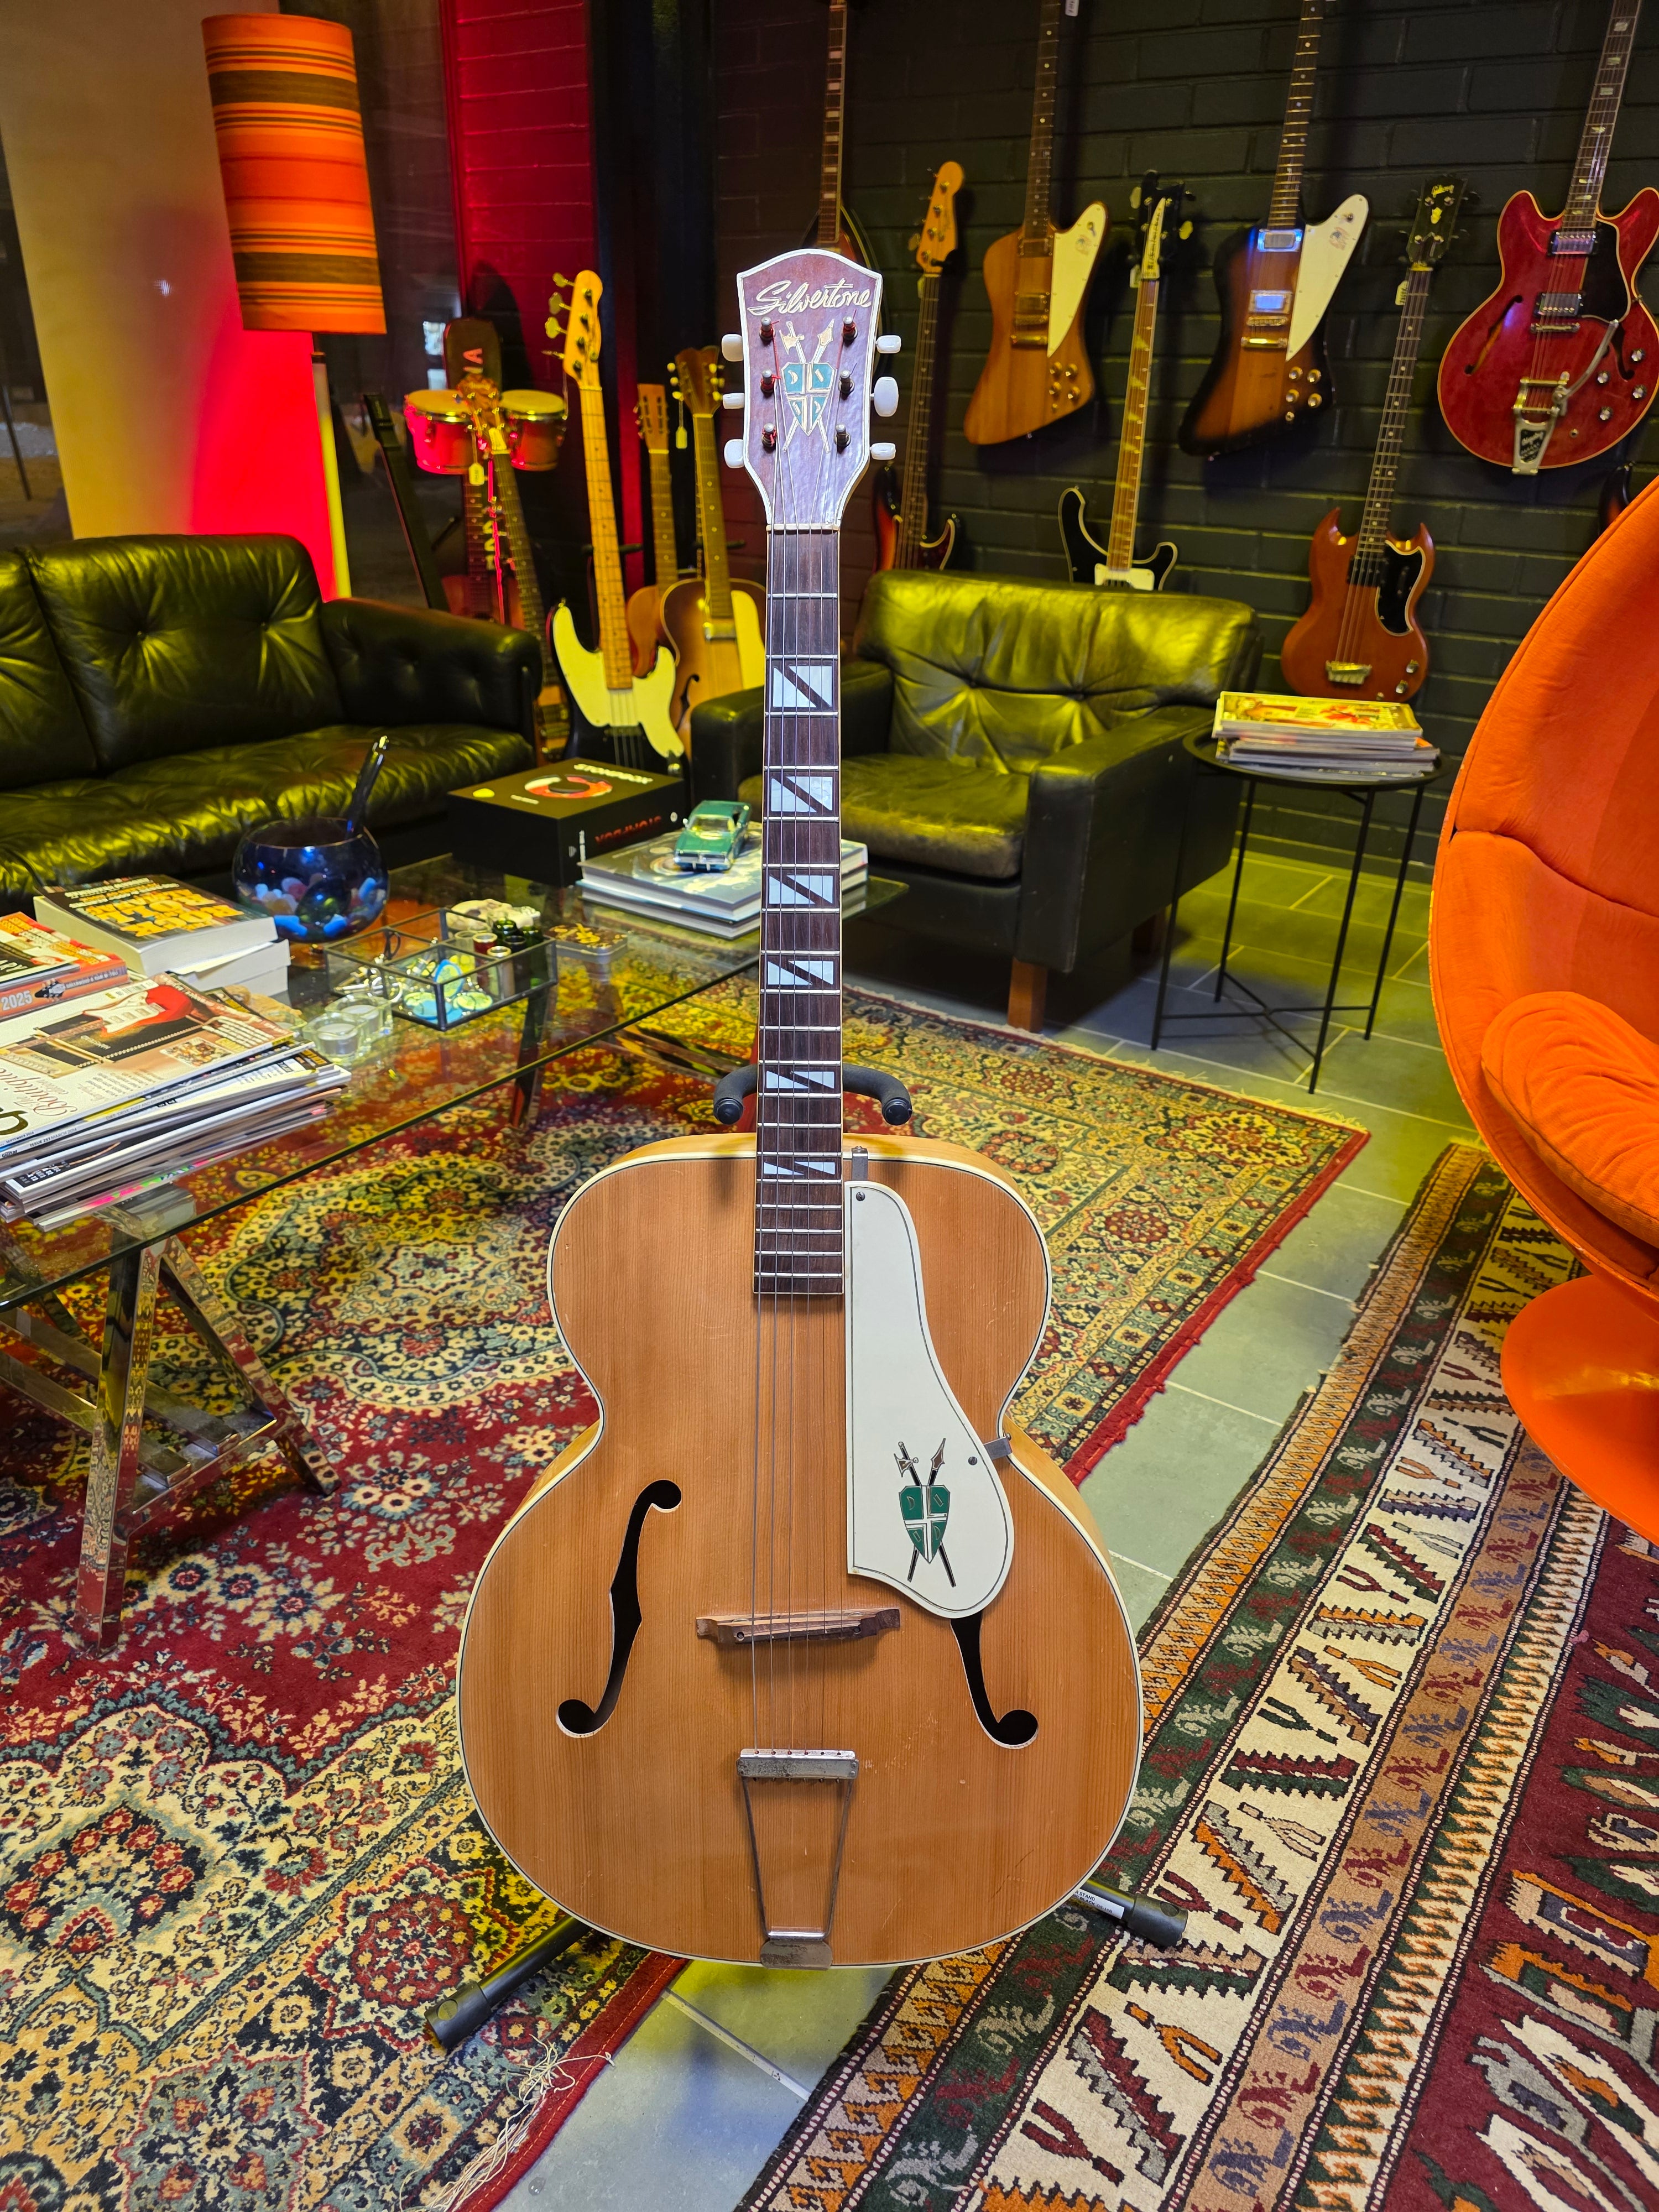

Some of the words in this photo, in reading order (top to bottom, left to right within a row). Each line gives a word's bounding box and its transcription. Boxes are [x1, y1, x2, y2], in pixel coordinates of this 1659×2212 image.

[747, 278, 872, 316] Silvertone
[98, 893, 217, 924] ROLL
[119, 904, 244, 937] ROCK
[2, 989, 33, 1010] 2025
[51, 1131, 67, 1140] MARCH
[2, 1150, 18, 1158] Guitar
